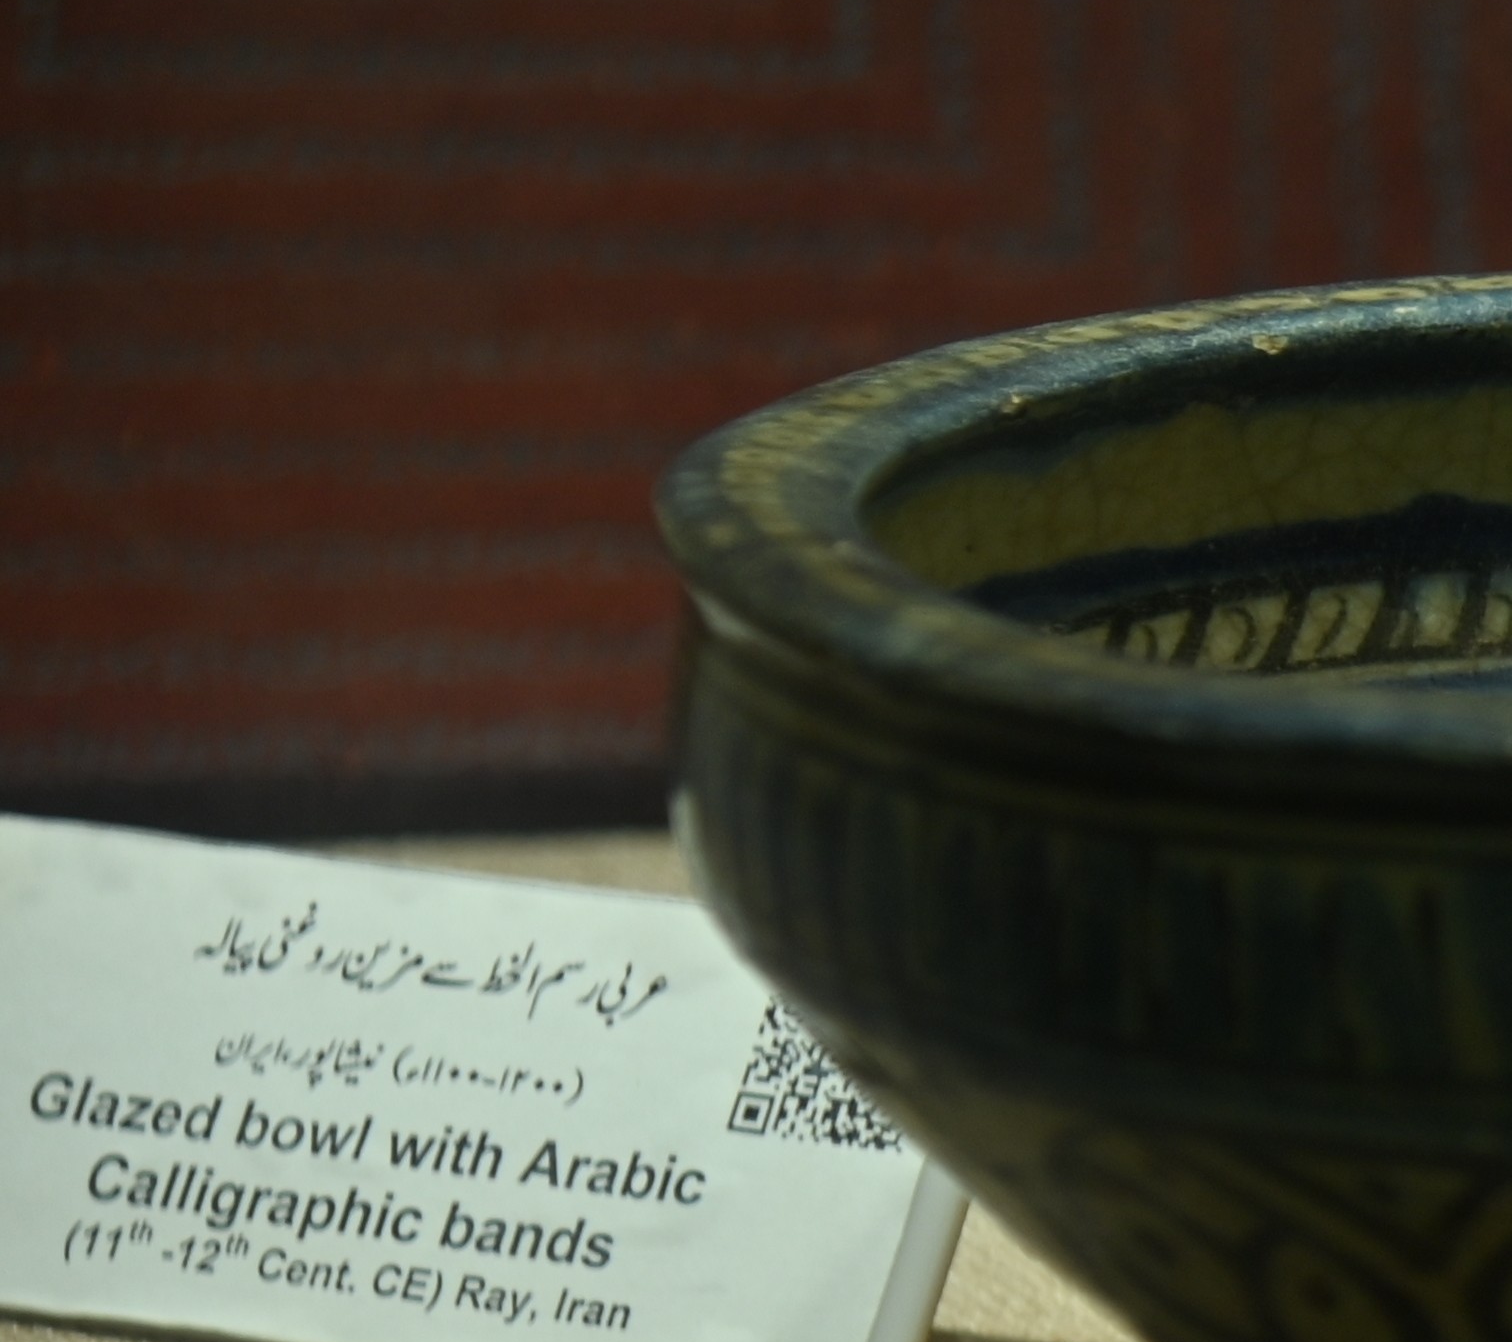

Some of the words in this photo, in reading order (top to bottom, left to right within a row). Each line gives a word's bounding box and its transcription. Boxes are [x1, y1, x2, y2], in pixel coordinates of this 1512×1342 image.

[193, 916, 254, 975] پیالہ
[258, 901, 346, 973] روغنی
[341, 940, 424, 992] مزین
[421, 962, 474, 988] سے
[479, 942, 542, 995] الخط
[527, 961, 597, 1020] رسم
[595, 961, 668, 1026] عربی
[30, 1072, 222, 1140] Glazed
[236, 1102, 372, 1160] bowl
[390, 1127, 502, 1180] with
[521, 1141, 707, 1205] Arabic
[88, 1153, 423, 1244] Calligraphic
[440, 1202, 615, 1269] bands
[64, 1219, 154, 1263] (11th
[258, 1248, 357, 1296] Cent.
[373, 1265, 445, 1313] CE)
[455, 1277, 538, 1325] Ray,
[556, 1289, 632, 1331] Iran
